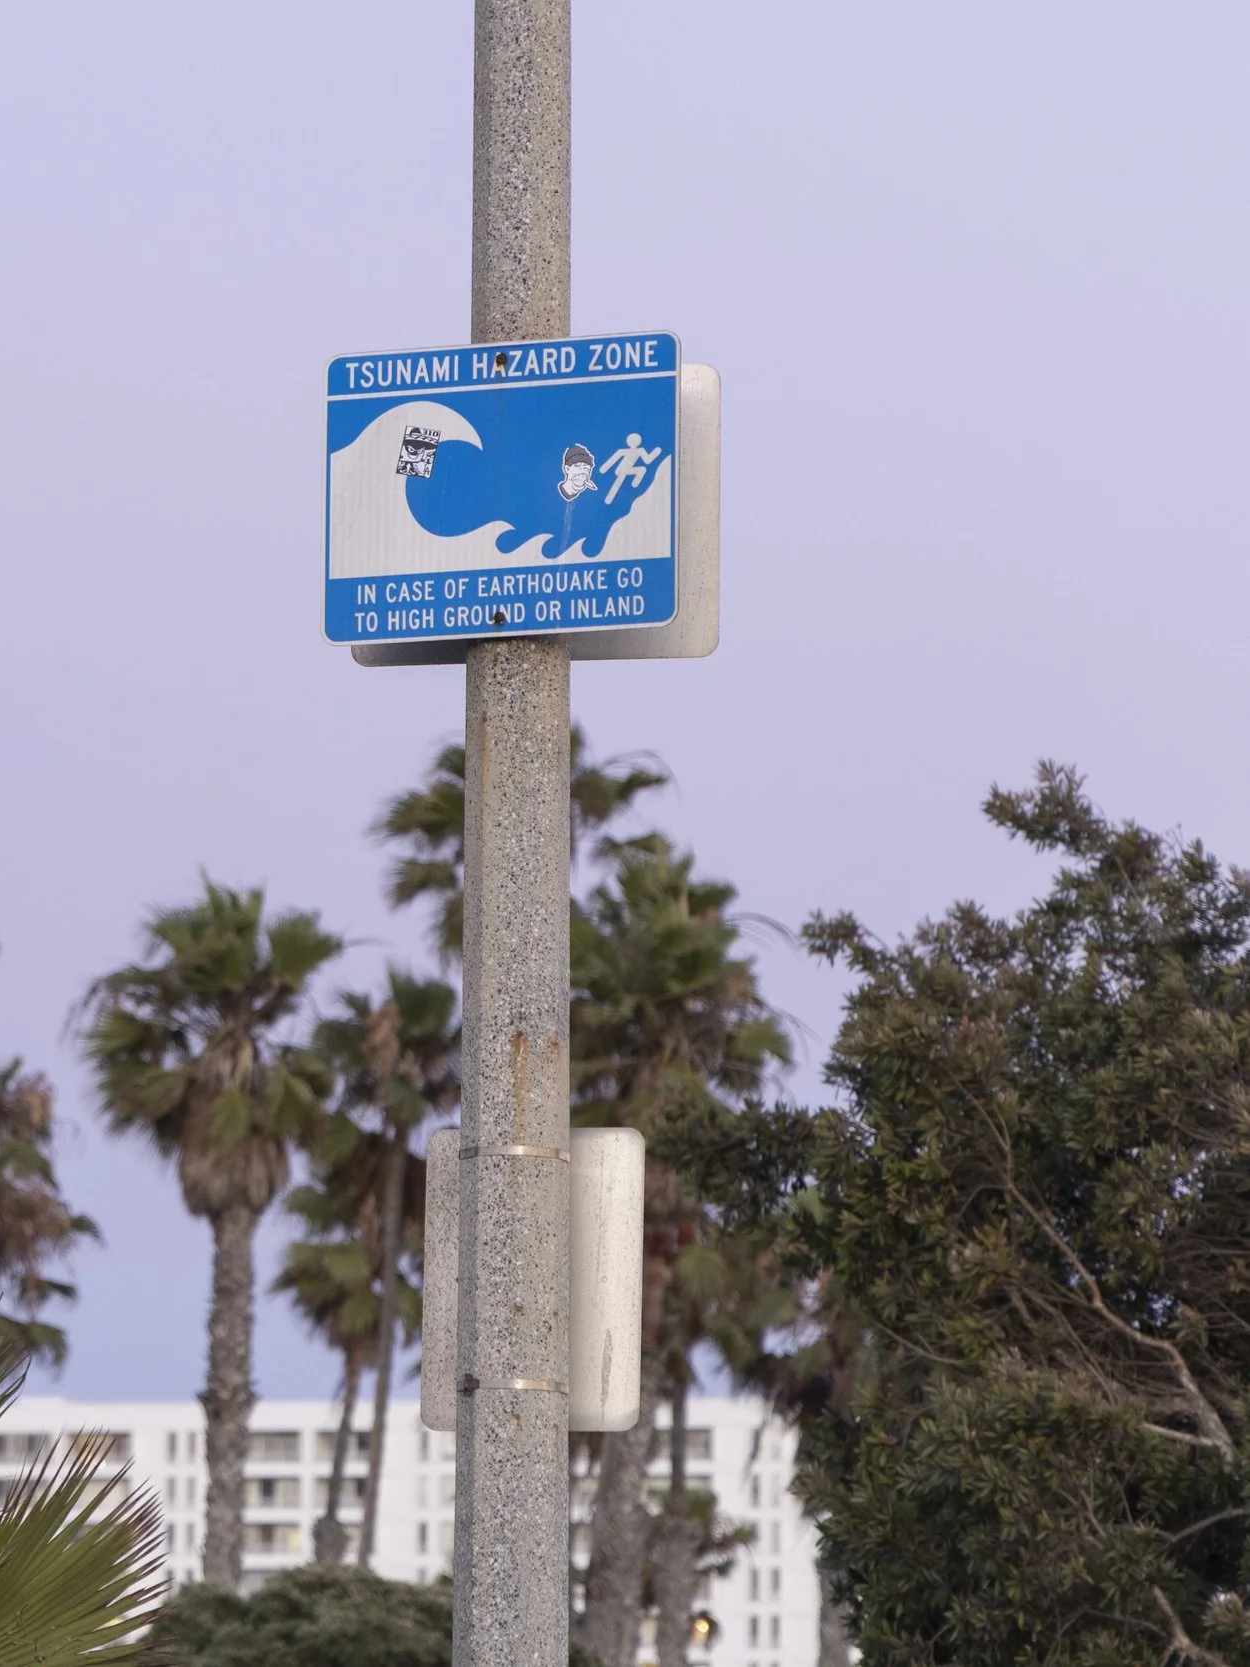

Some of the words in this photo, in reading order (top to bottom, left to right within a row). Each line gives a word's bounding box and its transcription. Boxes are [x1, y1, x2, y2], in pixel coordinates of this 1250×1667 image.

[345, 354, 459, 389] TSUNAMI
[472, 346, 576, 380] HAZARD
[588, 340, 659, 371] ZONE
[357, 583, 376, 605] IN
[385, 580, 435, 603] CASE
[444, 577, 469, 600] OF
[477, 569, 608, 598] EARTHQUAKE
[617, 566, 643, 589] GO
[355, 611, 378, 633] TO
[387, 608, 434, 631] HIGH
[443, 602, 526, 628] GROUND
[535, 600, 561, 622] OR
[570, 595, 645, 620] INLAND
